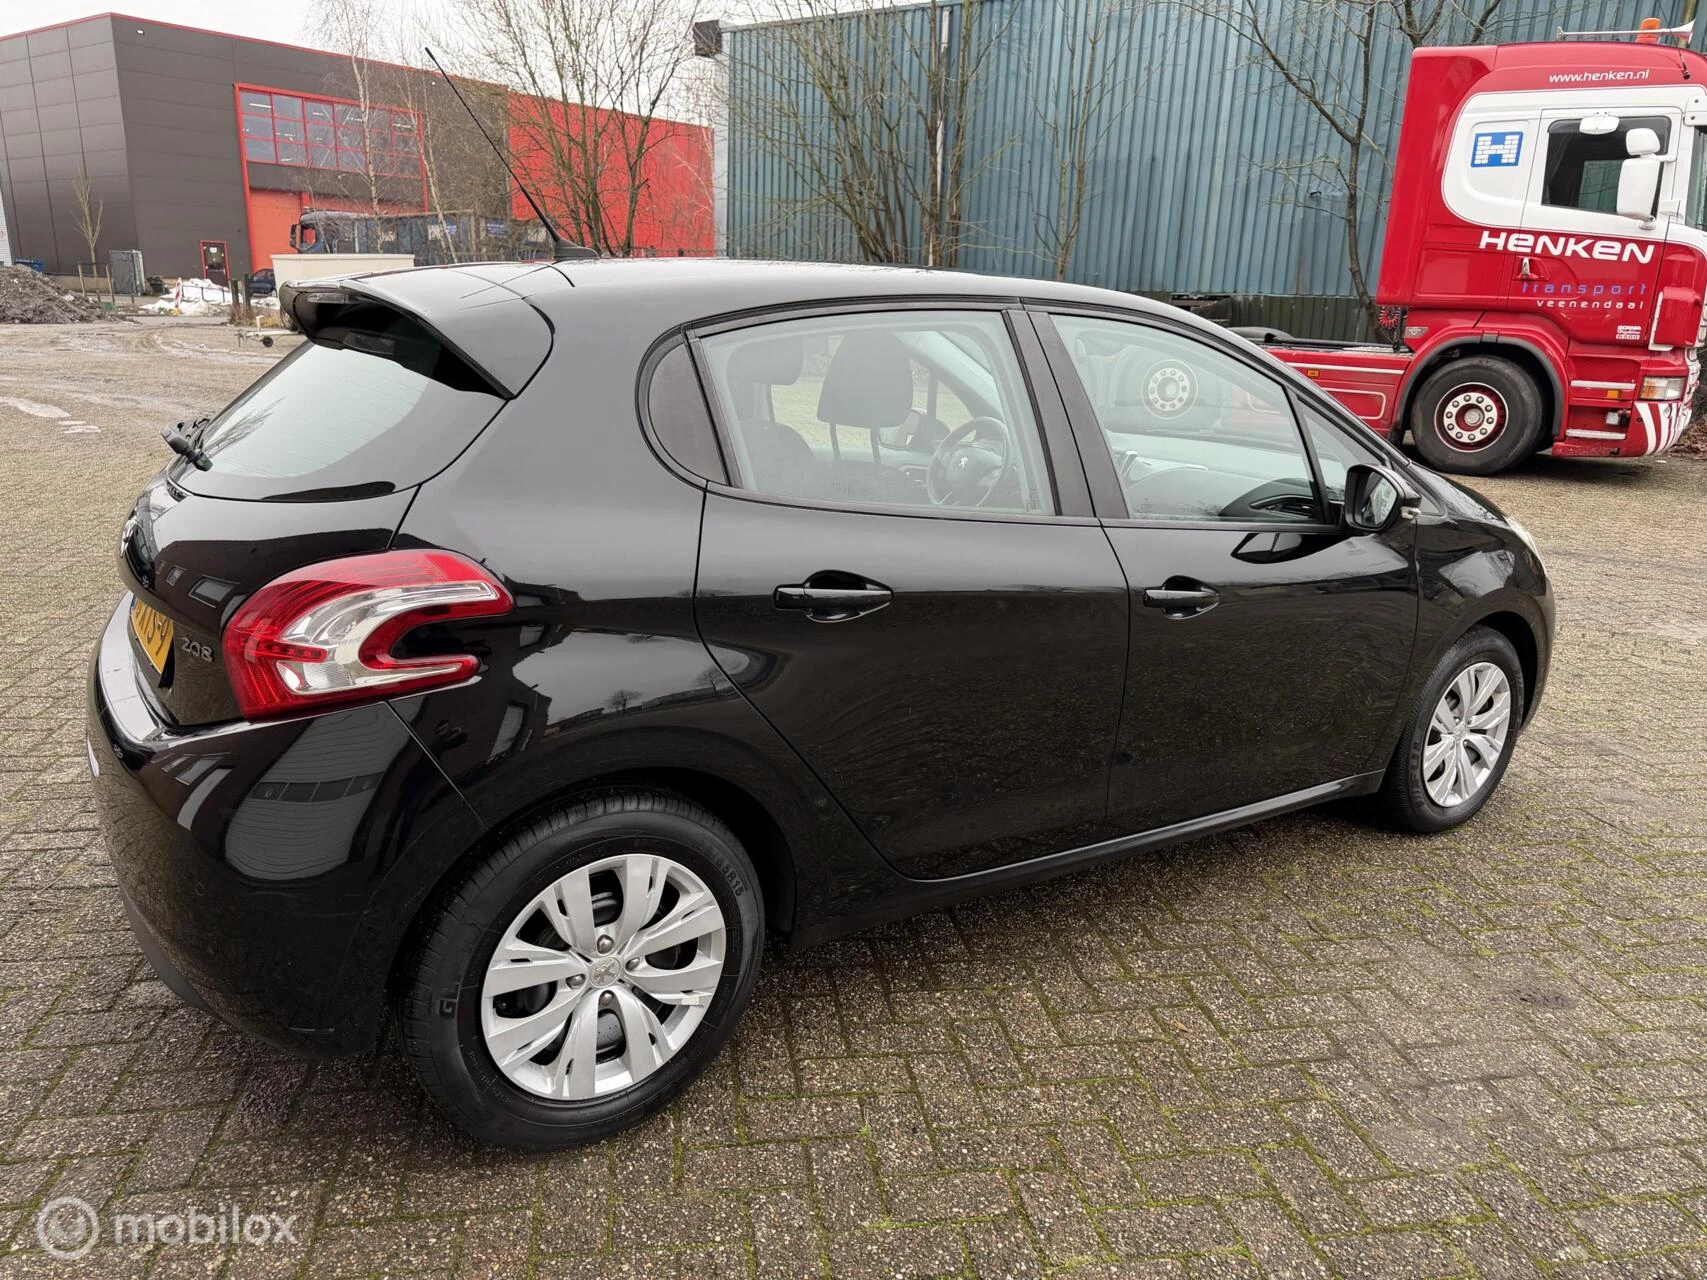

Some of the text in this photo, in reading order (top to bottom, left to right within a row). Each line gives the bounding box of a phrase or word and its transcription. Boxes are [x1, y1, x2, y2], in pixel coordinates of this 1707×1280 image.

[1548, 68, 1651, 83] www.henken.nl
[1474, 134, 1520, 165] H
[1522, 281, 1647, 297] transport
[1537, 300, 1643, 309] veenendaal
[181, 636, 214, 663] 208
